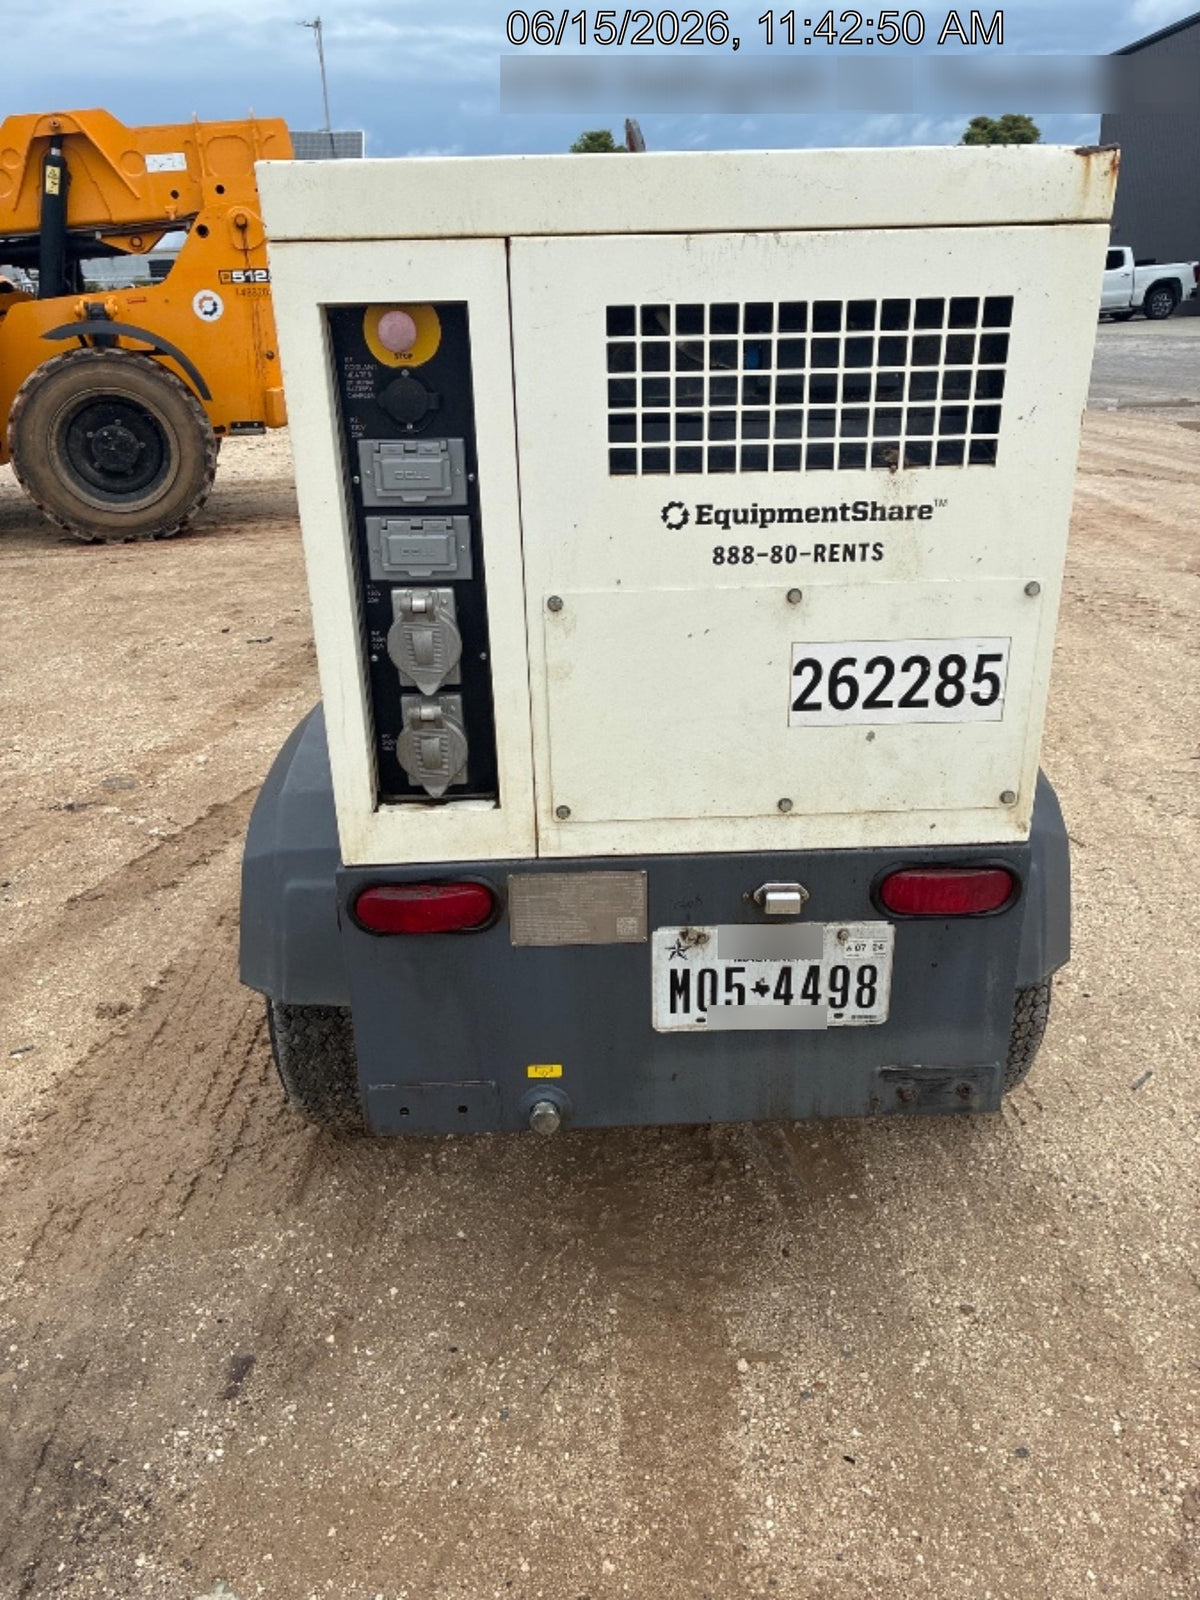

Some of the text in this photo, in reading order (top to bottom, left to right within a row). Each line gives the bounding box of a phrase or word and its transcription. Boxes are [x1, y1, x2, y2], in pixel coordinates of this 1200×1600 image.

[232, 269, 270, 282] 512
[394, 352, 414, 361] STOP
[695, 500, 934, 530] EquipmentShare
[712, 541, 885, 565] 888-80-RENTS
[791, 653, 1004, 713] 262285
